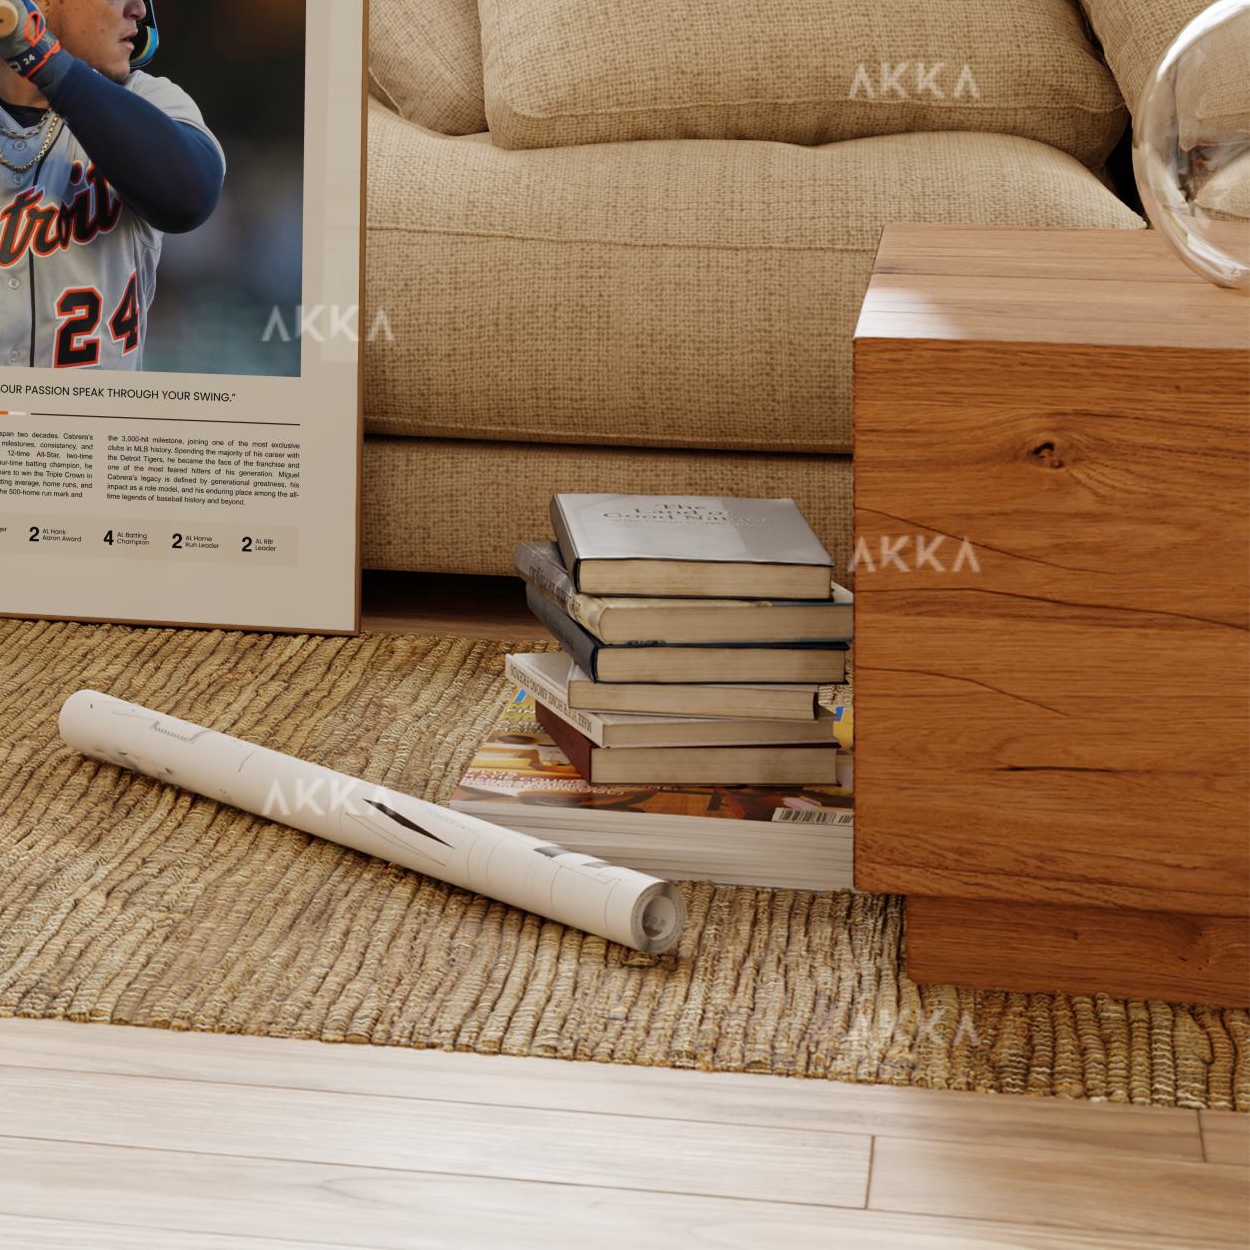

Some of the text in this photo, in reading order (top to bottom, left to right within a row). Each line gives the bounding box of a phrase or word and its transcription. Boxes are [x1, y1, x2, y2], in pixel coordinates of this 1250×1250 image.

[22, 53, 36, 66] 24
[52, 270, 140, 369] 24
[25, 385, 70, 396] PASSION
[72, 386, 104, 398] SPEAK
[107, 388, 159, 399] THROUGH
[161, 390, 191, 401] YOUR
[29, 526, 39, 542] 2
[104, 530, 114, 545] 4
[172, 533, 182, 548] 2
[242, 537, 252, 552] 2
